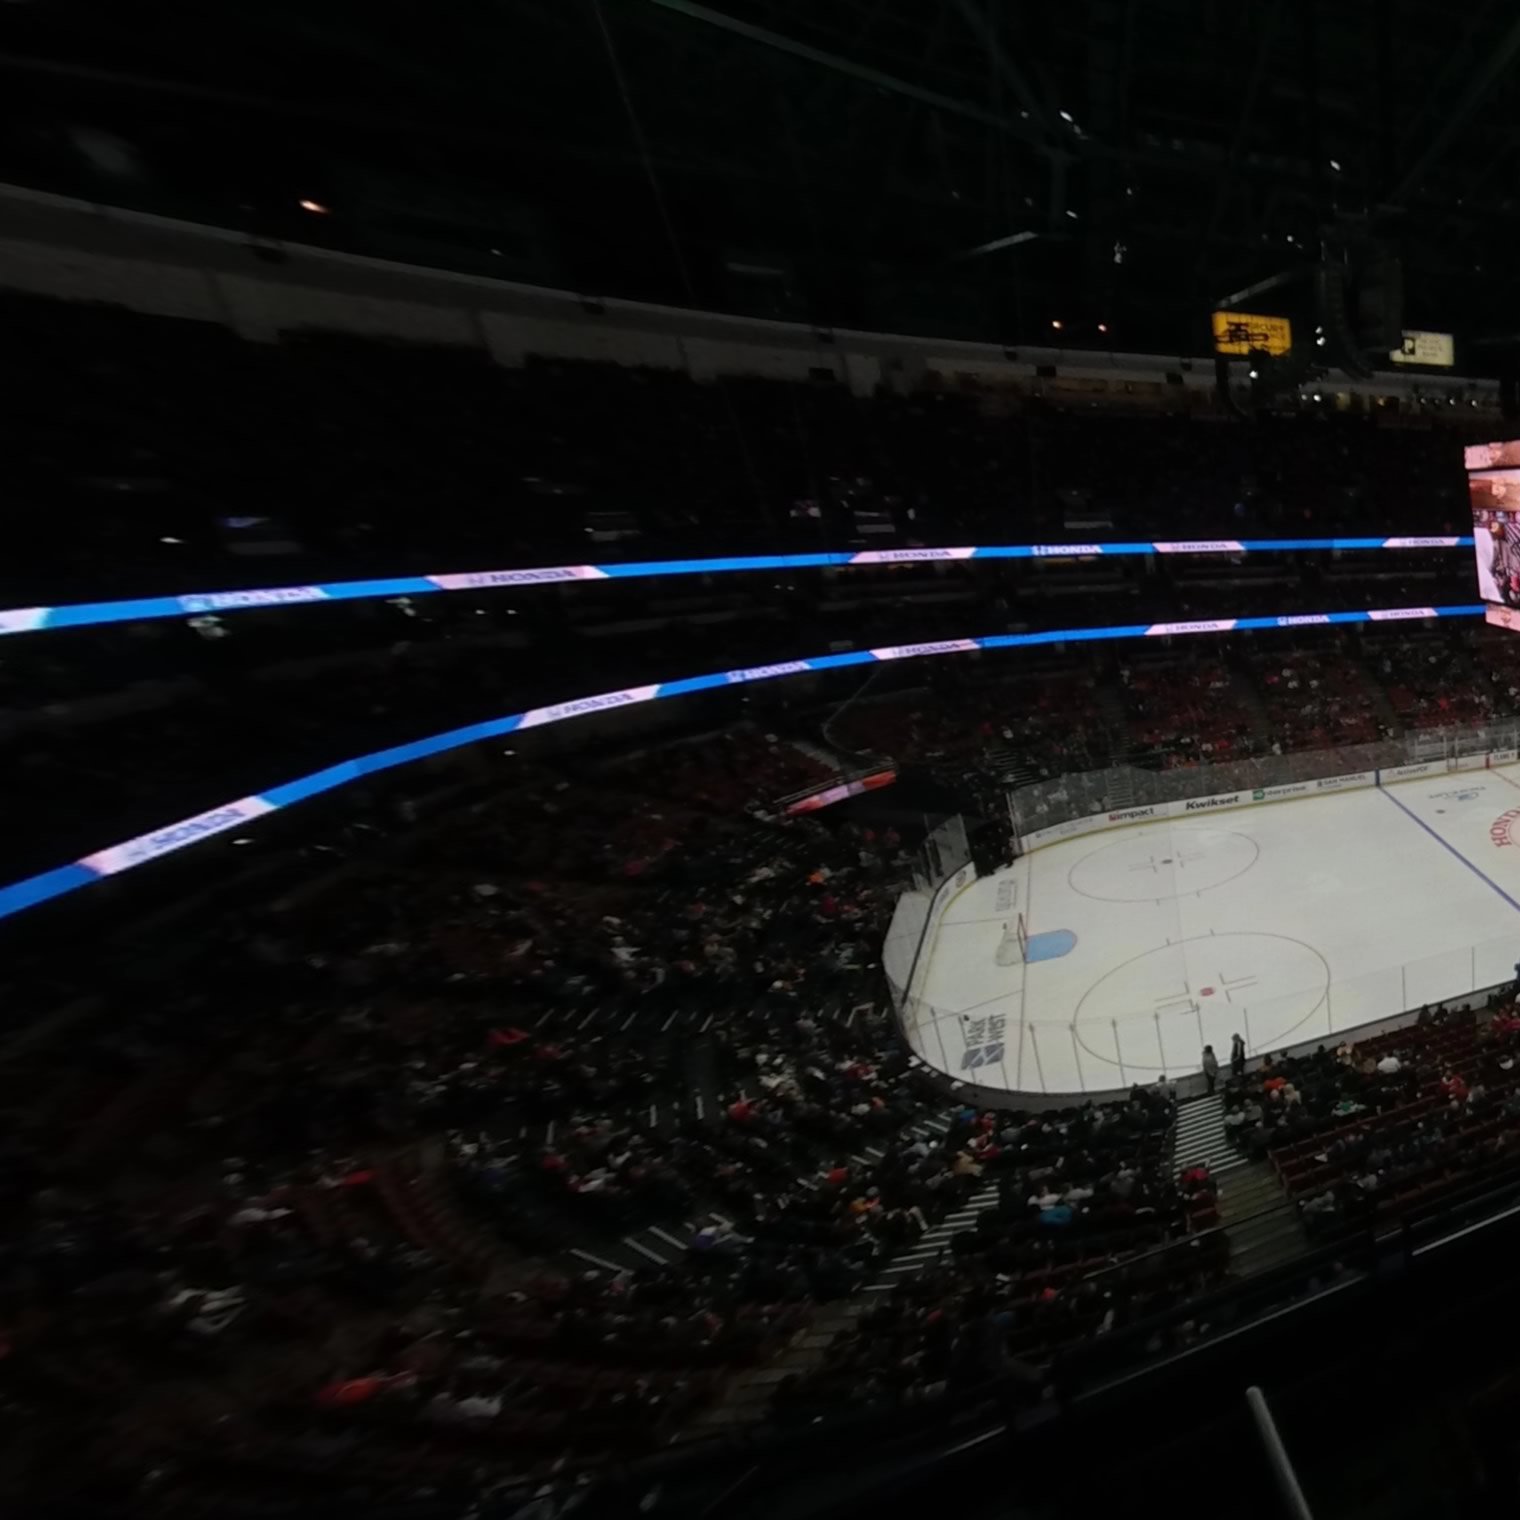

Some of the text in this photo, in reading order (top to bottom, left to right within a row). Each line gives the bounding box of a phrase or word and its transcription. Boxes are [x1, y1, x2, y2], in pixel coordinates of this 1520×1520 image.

[1047, 545, 1101, 555] HONDA
[1182, 543, 1228, 551] HONDA
[893, 551, 952, 559] HONDA
[491, 570, 576, 583] HONDA
[1288, 615, 1328, 624] HONDA
[1175, 623, 1219, 631] HONDA
[905, 643, 961, 655] HONDA
[564, 693, 634, 714] HONDA
[1186, 795, 1239, 810] Kwikset
[1117, 807, 1154, 820] impact
